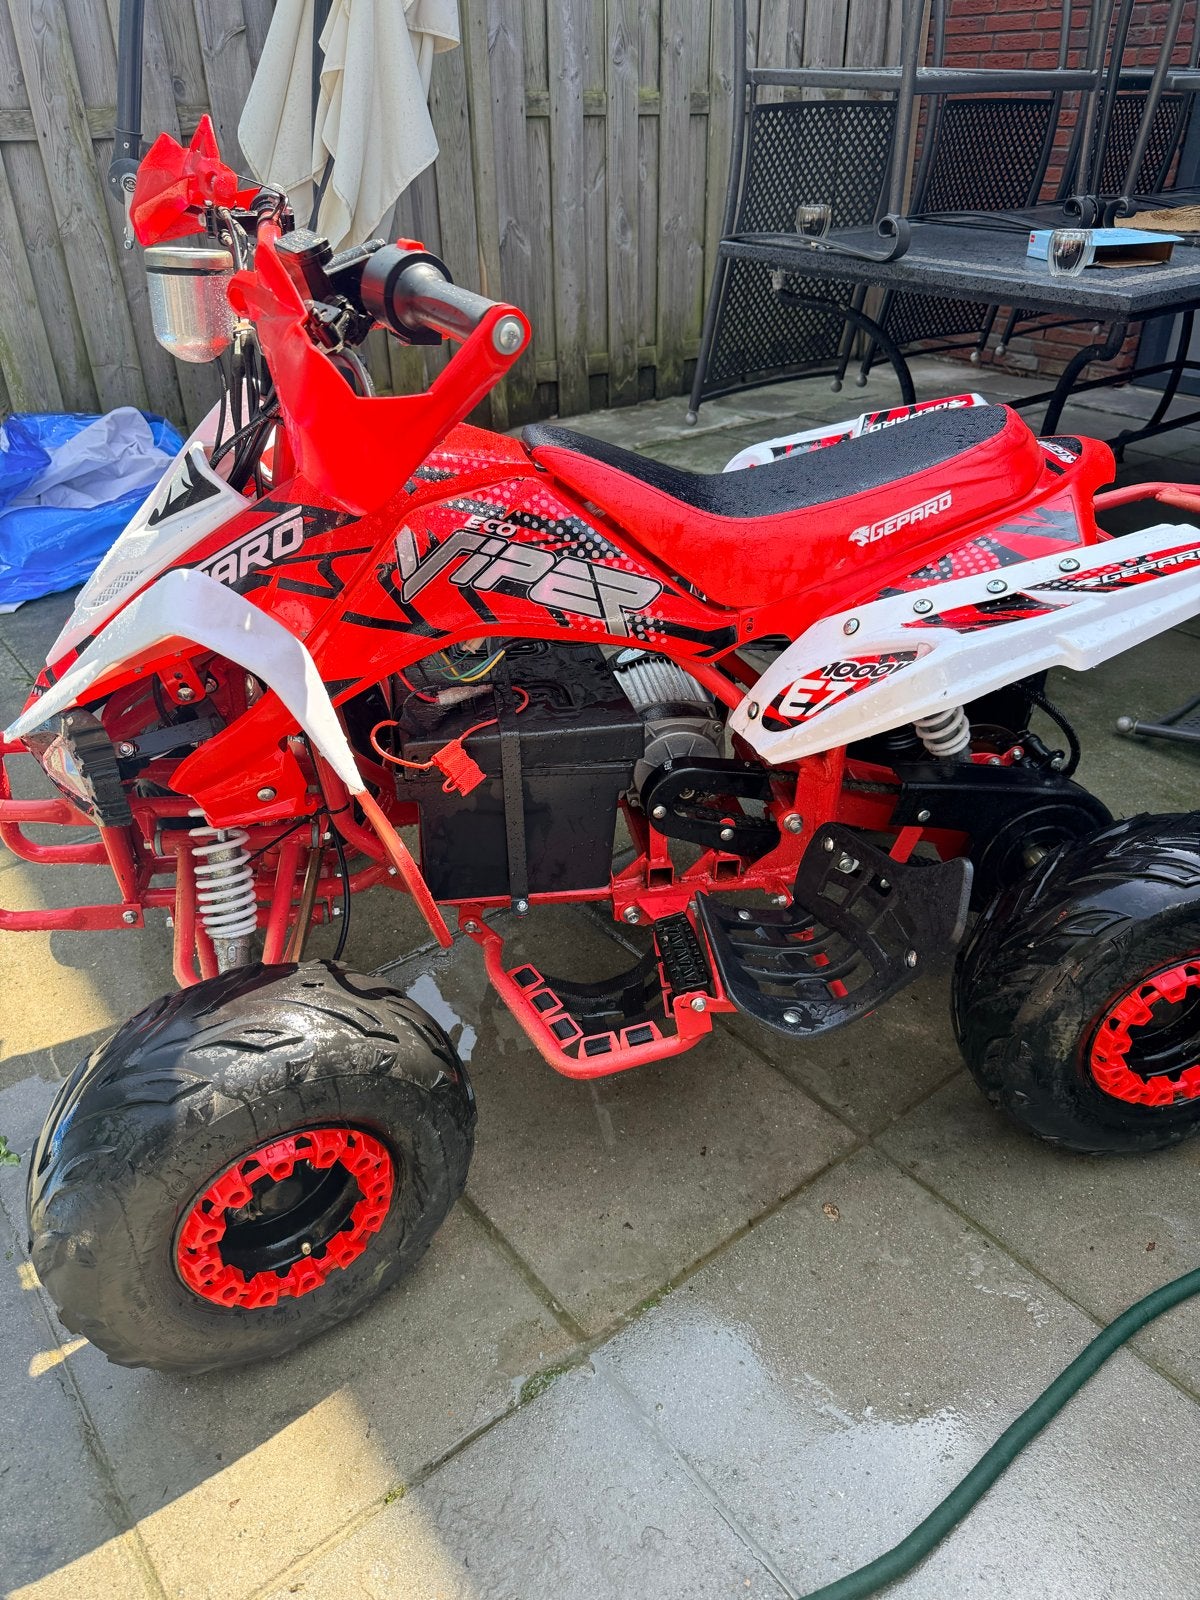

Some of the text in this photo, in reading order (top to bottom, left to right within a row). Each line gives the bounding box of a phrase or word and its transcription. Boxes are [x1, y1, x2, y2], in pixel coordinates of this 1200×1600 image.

[463, 515, 518, 537] ECO
[869, 489, 952, 543] GEPARD
[778, 678, 857, 718] E7
